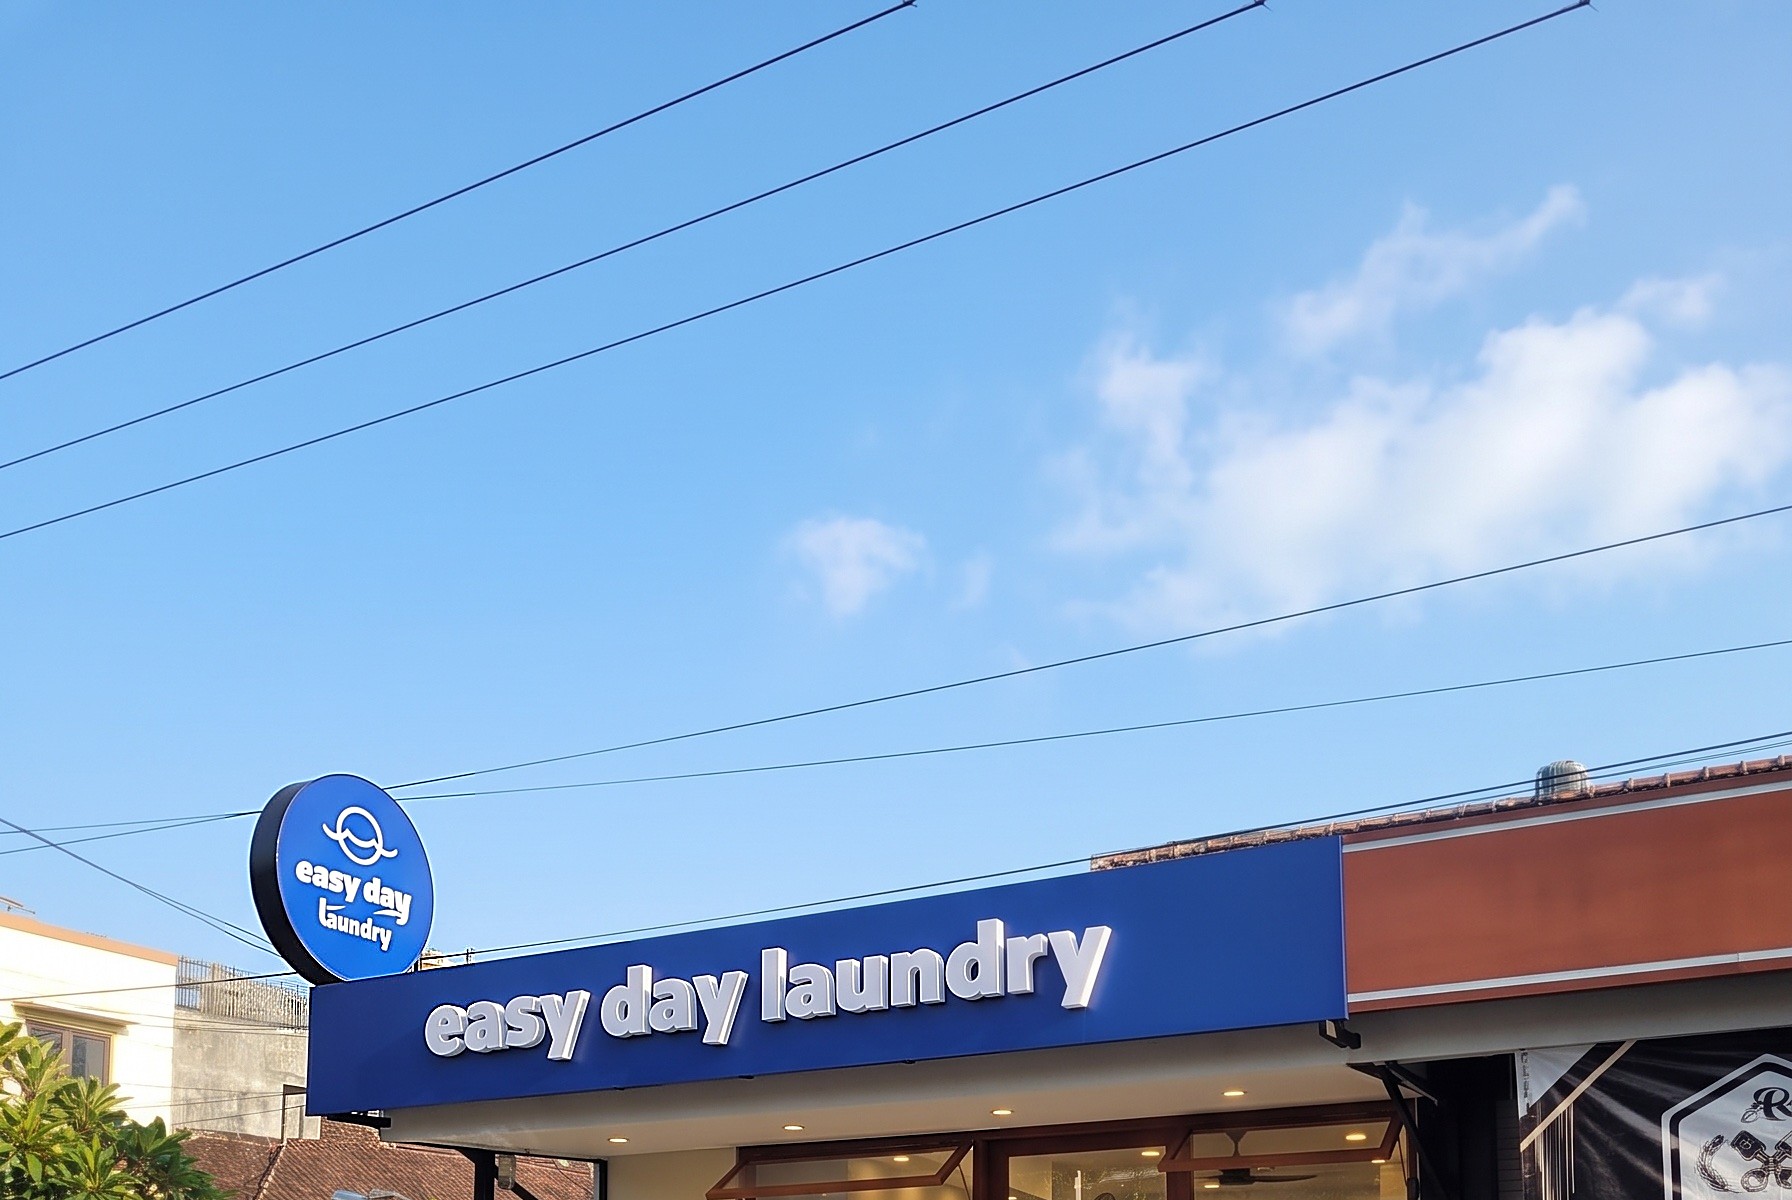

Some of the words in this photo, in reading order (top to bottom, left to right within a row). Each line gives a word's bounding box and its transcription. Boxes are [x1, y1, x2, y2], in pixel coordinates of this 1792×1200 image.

[295, 861, 361, 903] easy
[363, 877, 412, 926] day
[318, 897, 393, 952] laundry
[425, 990, 590, 1061] easy
[601, 965, 749, 1045] day
[761, 917, 1112, 1022] laundry
